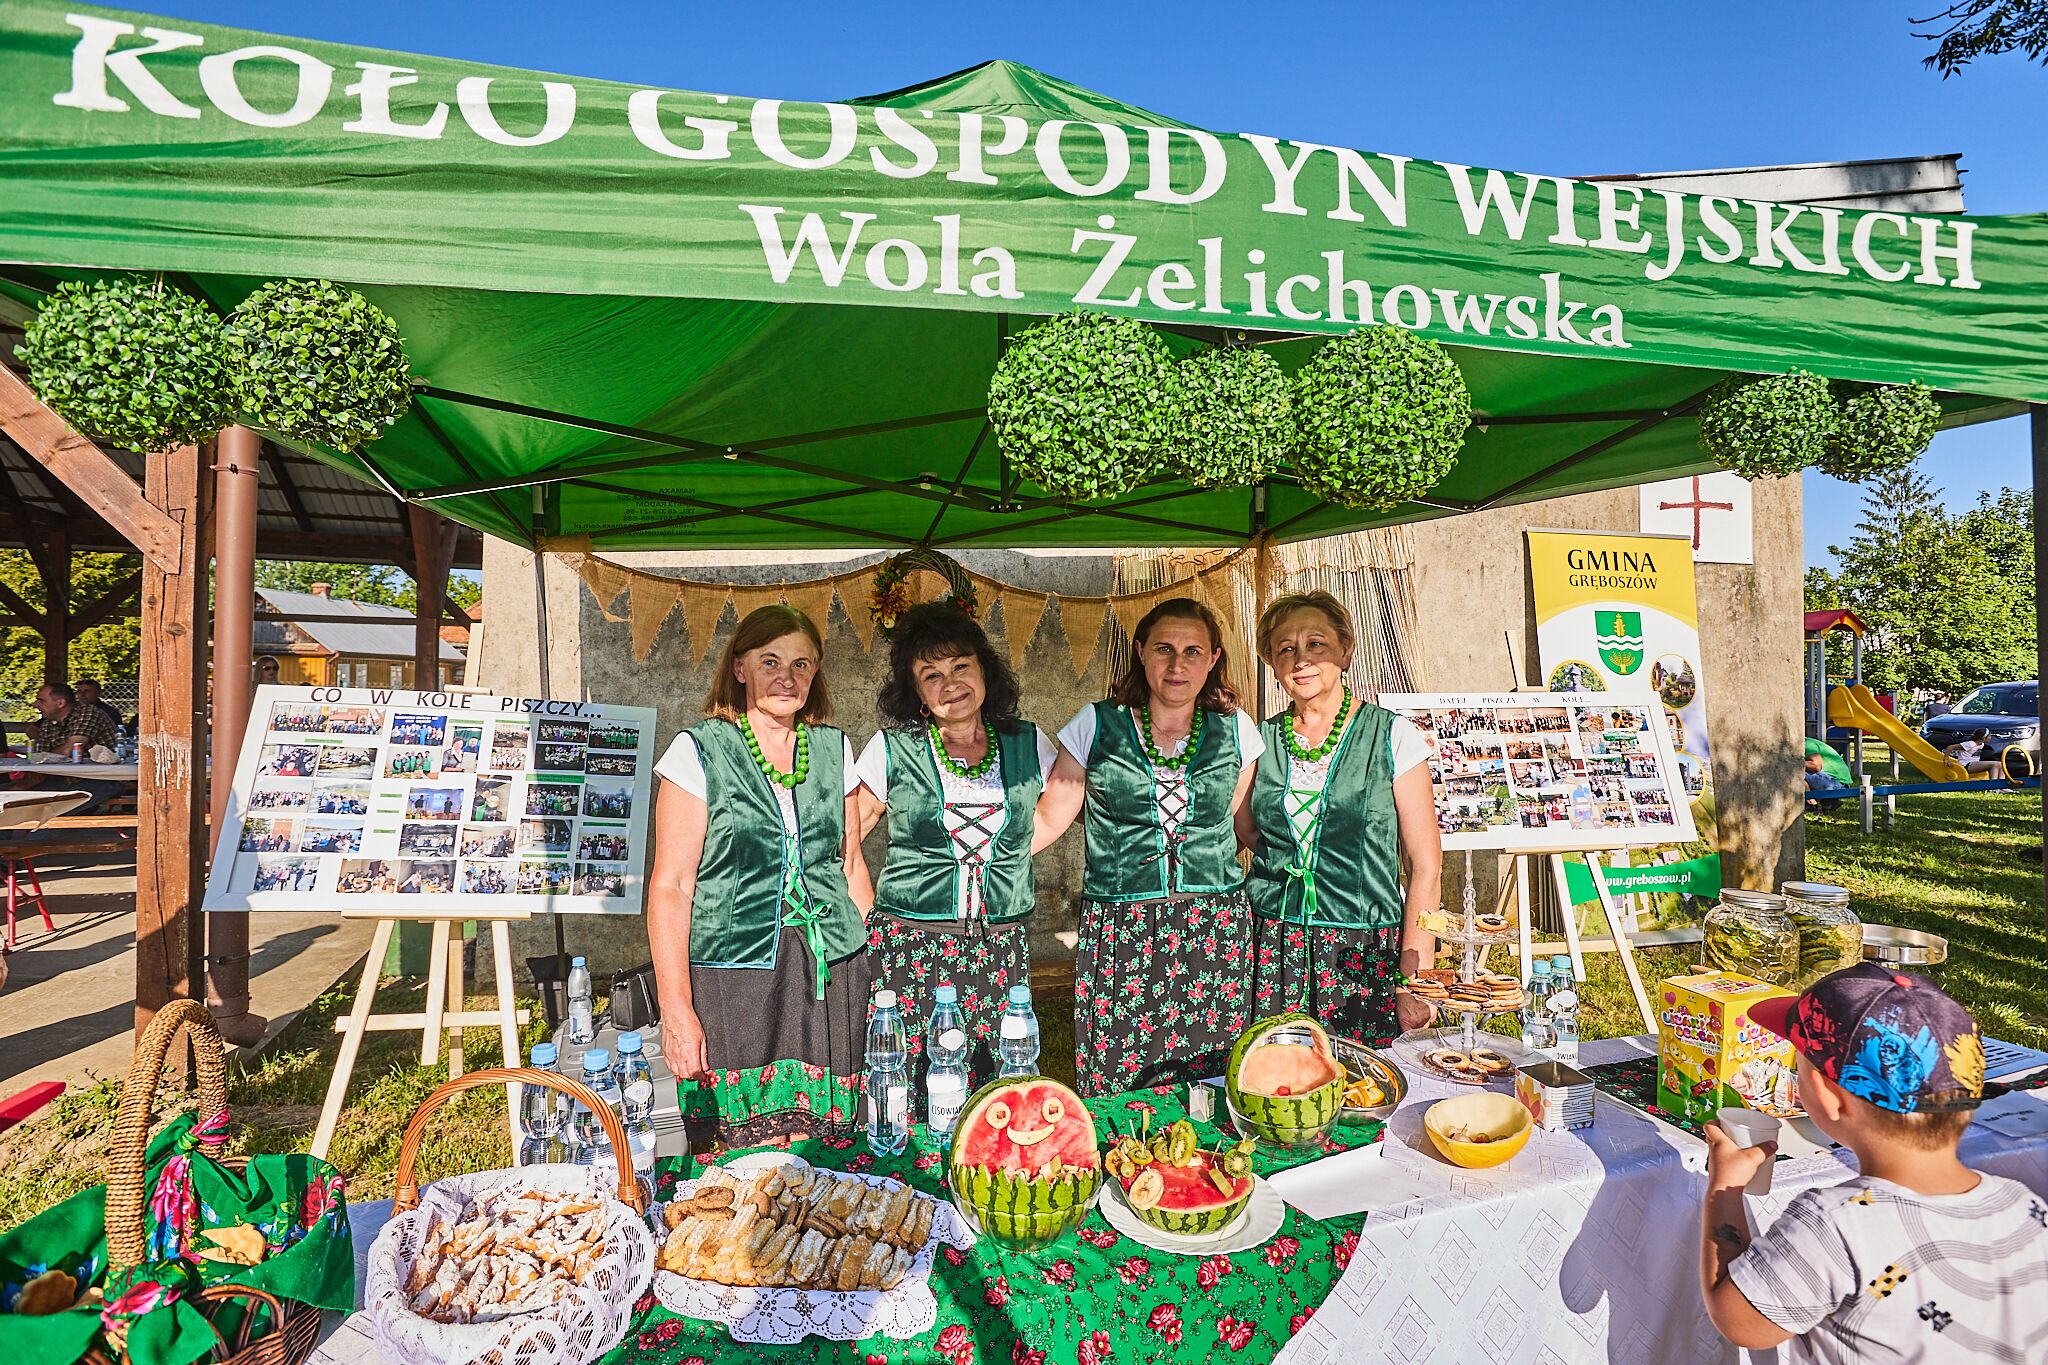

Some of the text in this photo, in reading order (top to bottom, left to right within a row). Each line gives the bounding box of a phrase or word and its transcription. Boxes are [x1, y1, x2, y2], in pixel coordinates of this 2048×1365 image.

[53, 13, 1982, 291] KOŁO GOSPODYN WIEJSKICH
[738, 203, 1632, 348] Wola Żelichowska
[1567, 549, 1657, 573] GMINA
[1569, 573, 1658, 590] GRĘBOSZÓW
[310, 687, 602, 719] CO W KOLE PISZCZY...
[1592, 871, 1691, 889] ww.greboszow.pl
